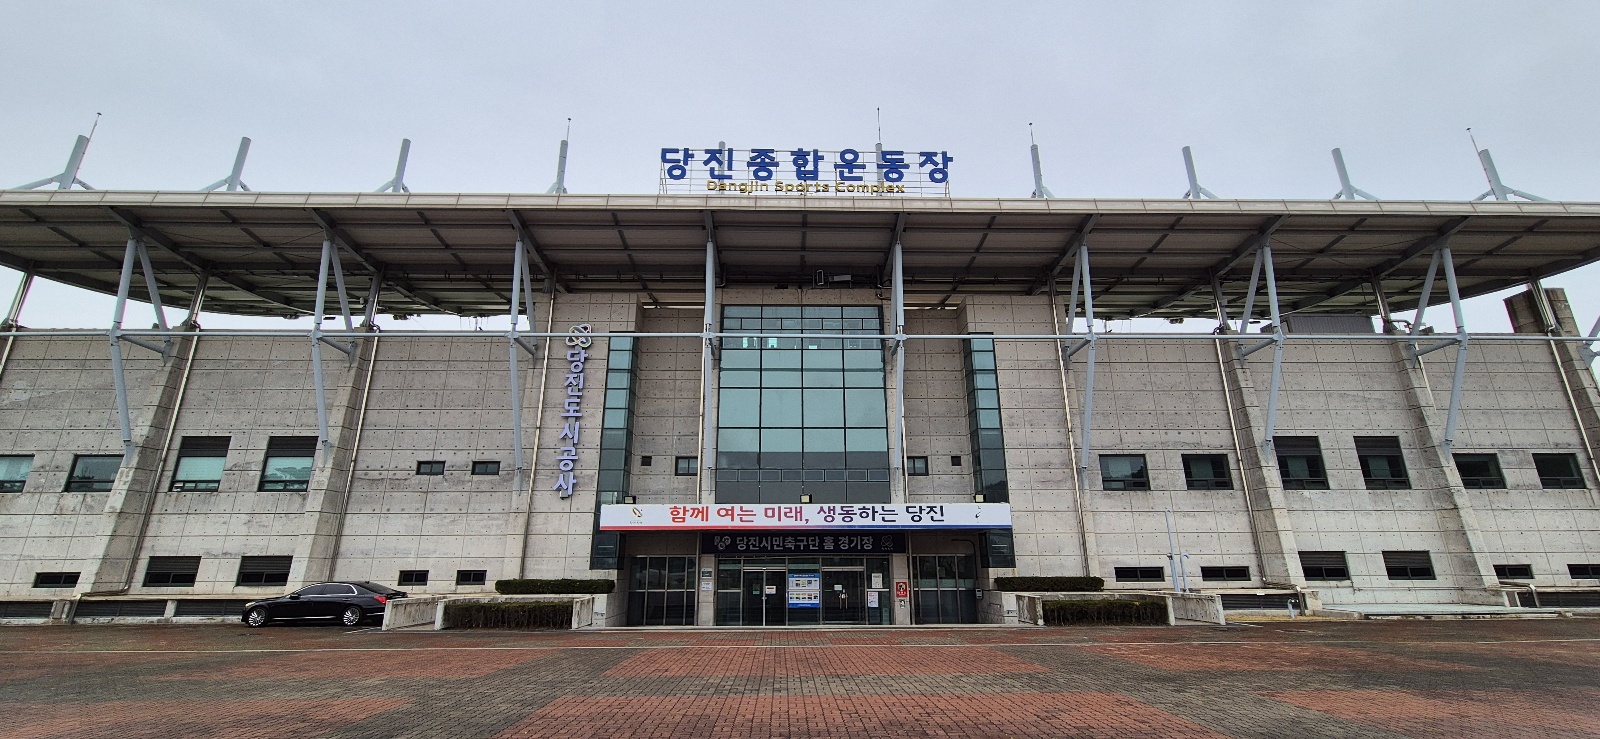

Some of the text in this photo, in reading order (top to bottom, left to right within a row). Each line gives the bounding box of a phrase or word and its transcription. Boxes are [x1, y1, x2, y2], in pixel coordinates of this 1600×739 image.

[660, 147, 953, 183] 당진종합운동장
[706, 180, 906, 193] Dangjin Sports Complex
[552, 349, 589, 496] 당진도시공사
[669, 505, 945, 524] 함께 여는 미래, 생동하는 당진
[736, 535, 874, 551] 당진시민축구단 홈 경기장
